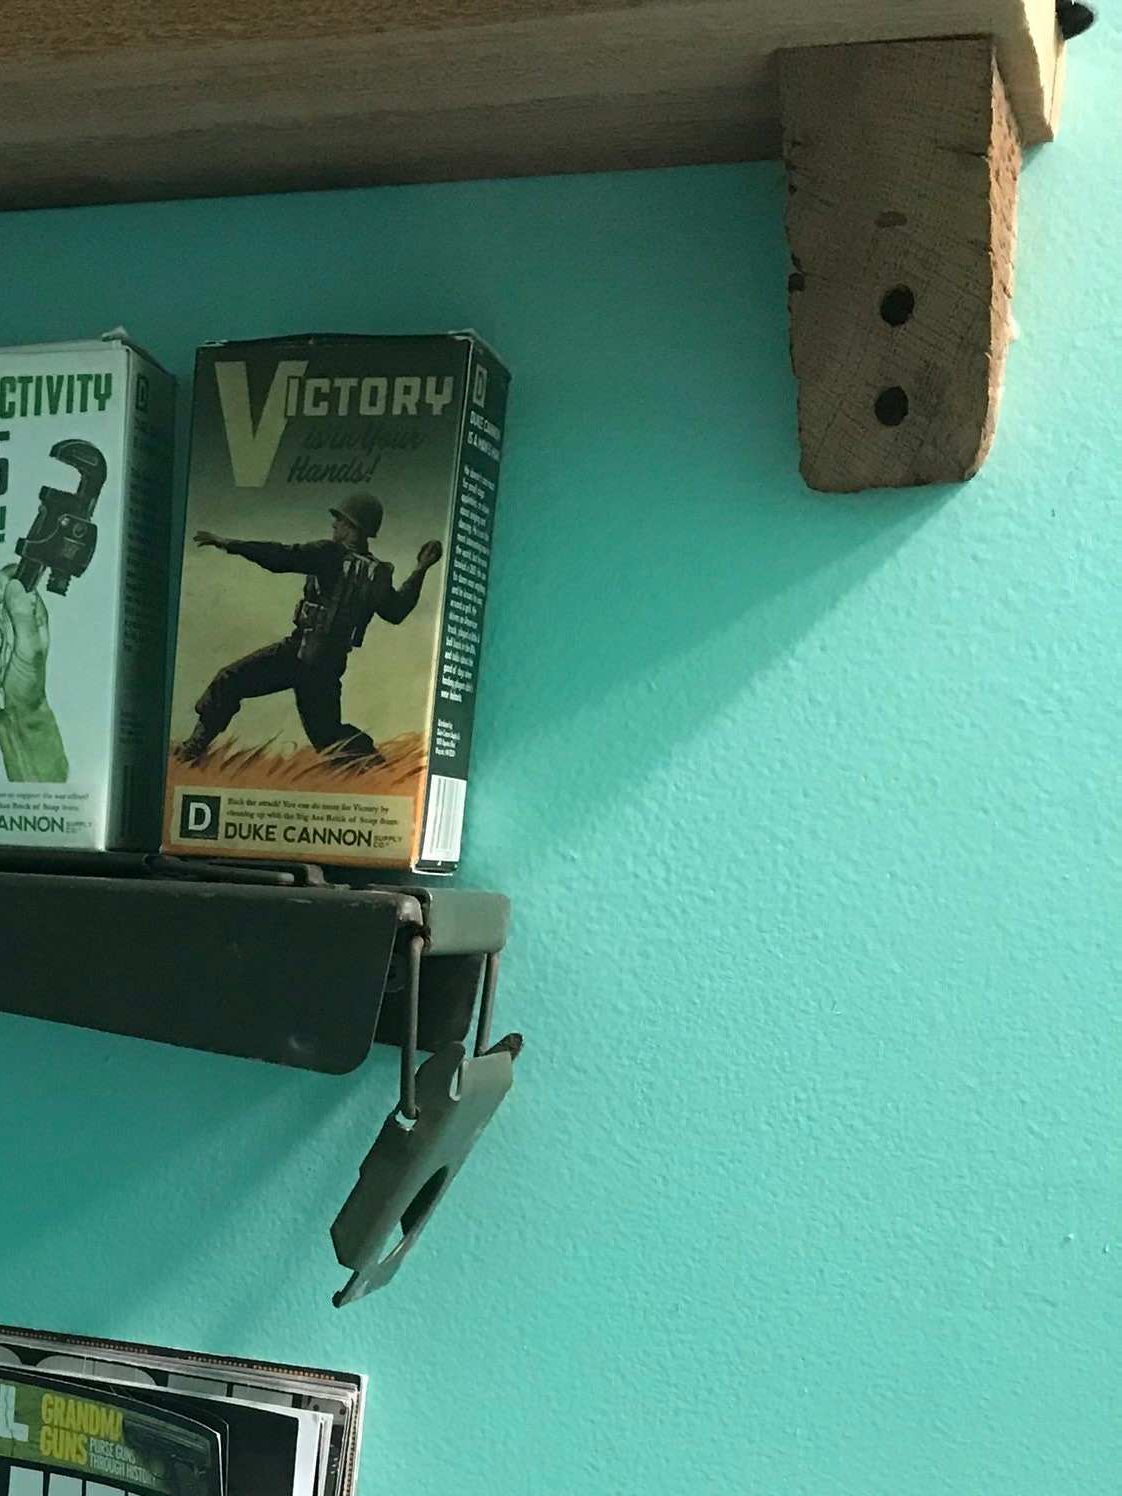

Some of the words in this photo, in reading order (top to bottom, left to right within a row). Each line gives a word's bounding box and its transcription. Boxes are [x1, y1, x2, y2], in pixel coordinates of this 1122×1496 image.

[214, 359, 454, 488] VICTORY
[287, 454, 382, 484] Hands!
[188, 802, 212, 831] D
[224, 821, 278, 842] DUKE
[283, 825, 372, 848] CANNON
[41, 1392, 124, 1442] GRANDMA
[39, 1425, 88, 1466] GUNS
[89, 1438, 114, 1458] PURSE
[89, 1453, 126, 1476] THROUGH
